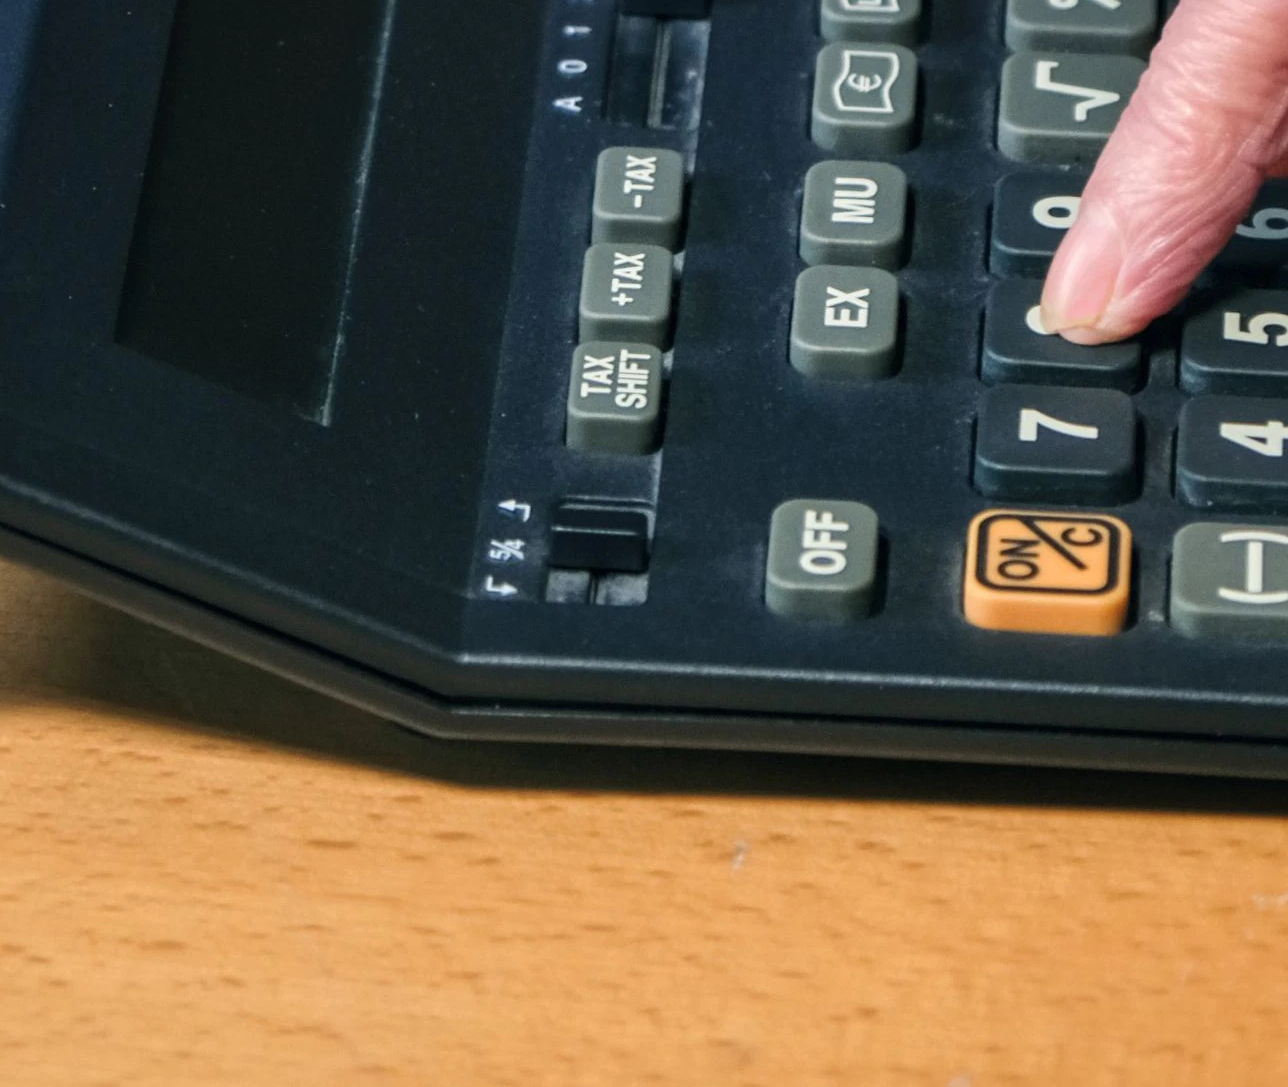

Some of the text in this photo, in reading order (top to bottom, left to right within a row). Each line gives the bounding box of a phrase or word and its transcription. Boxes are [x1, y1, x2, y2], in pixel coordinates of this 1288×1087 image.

[563, 24, 592, 36] 1
[557, 59, 588, 77] 0
[552, 96, 583, 112] A
[623, 155, 657, 208] -TAX
[832, 177, 878, 224] MU
[612, 251, 645, 306] +TAX
[824, 287, 870, 328] EX
[581, 354, 615, 398] TAX
[616, 349, 651, 409] SHIFT
[1019, 409, 1099, 442] 7
[800, 510, 849, 575] OFF
